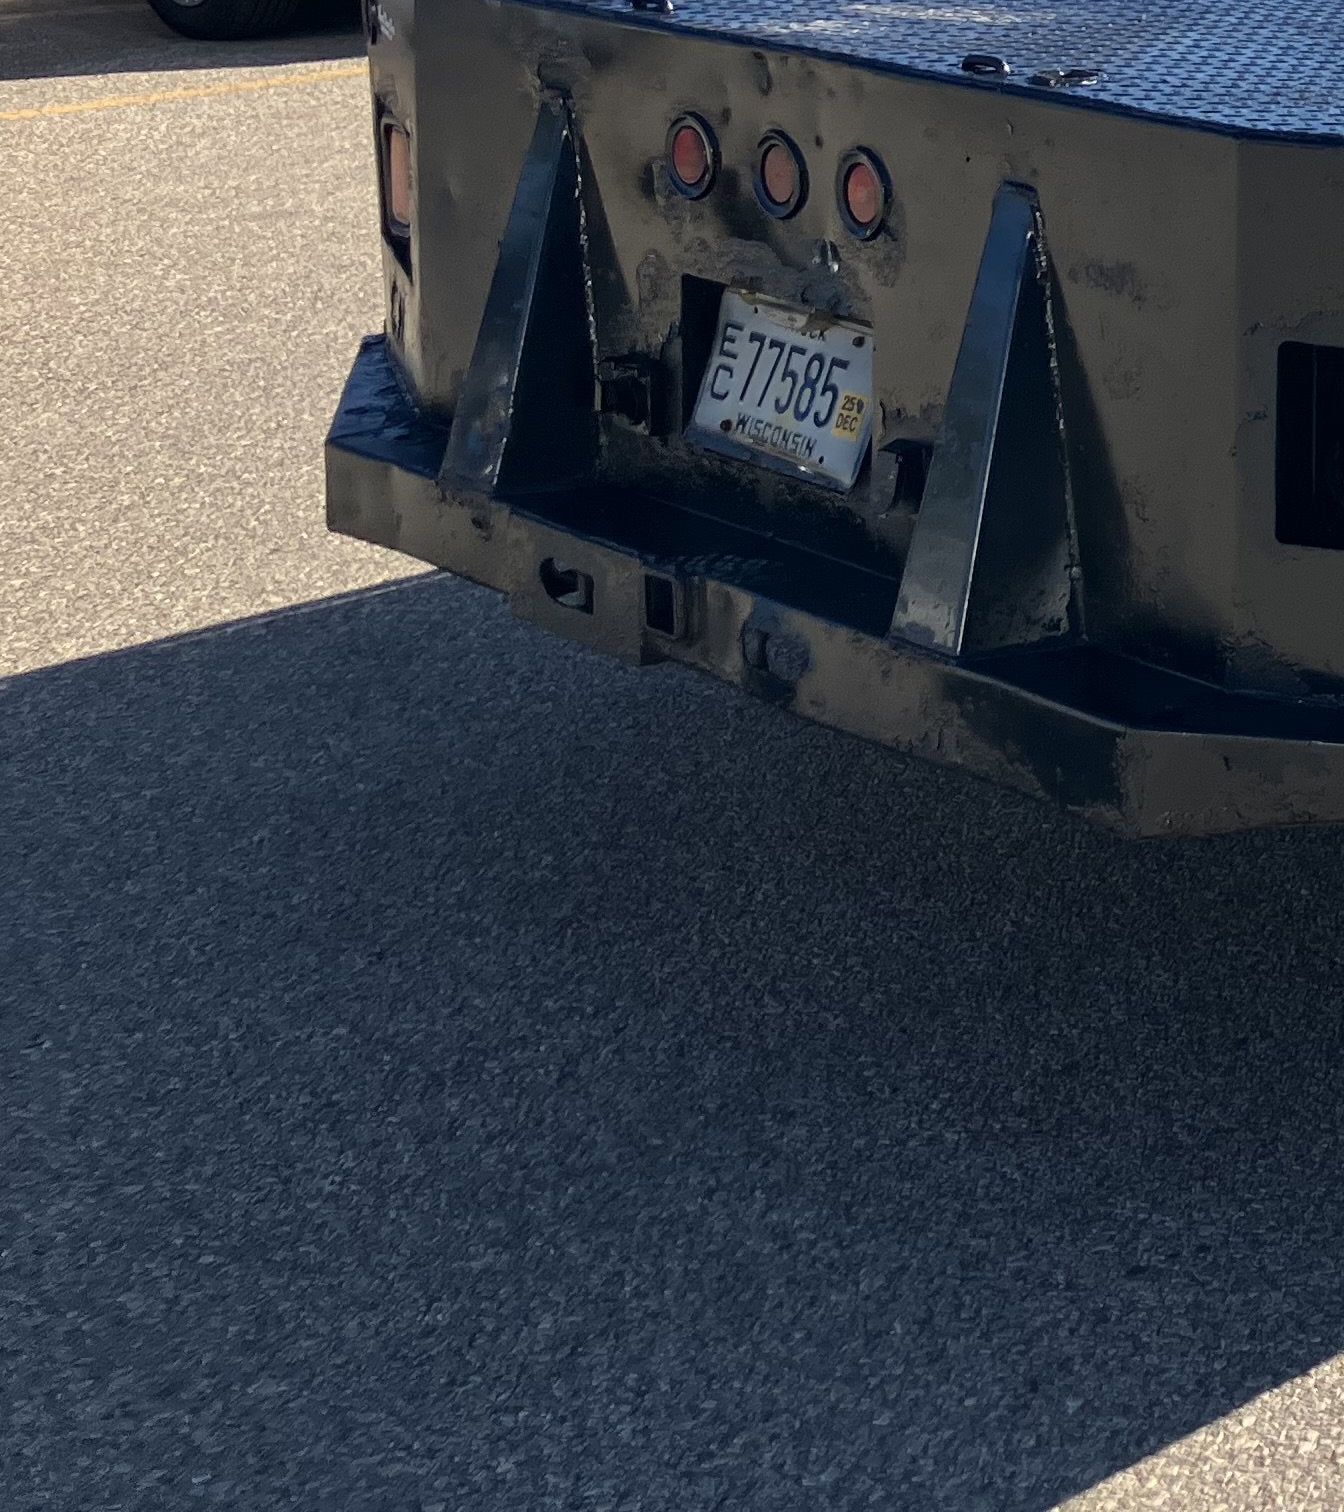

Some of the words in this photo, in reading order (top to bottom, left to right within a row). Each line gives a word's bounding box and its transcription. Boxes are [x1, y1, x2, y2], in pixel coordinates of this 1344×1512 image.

[739, 330, 850, 429] 77585
[841, 395, 856, 412] 25
[733, 411, 818, 458] WISCONSIN
[835, 412, 859, 432] DEC
